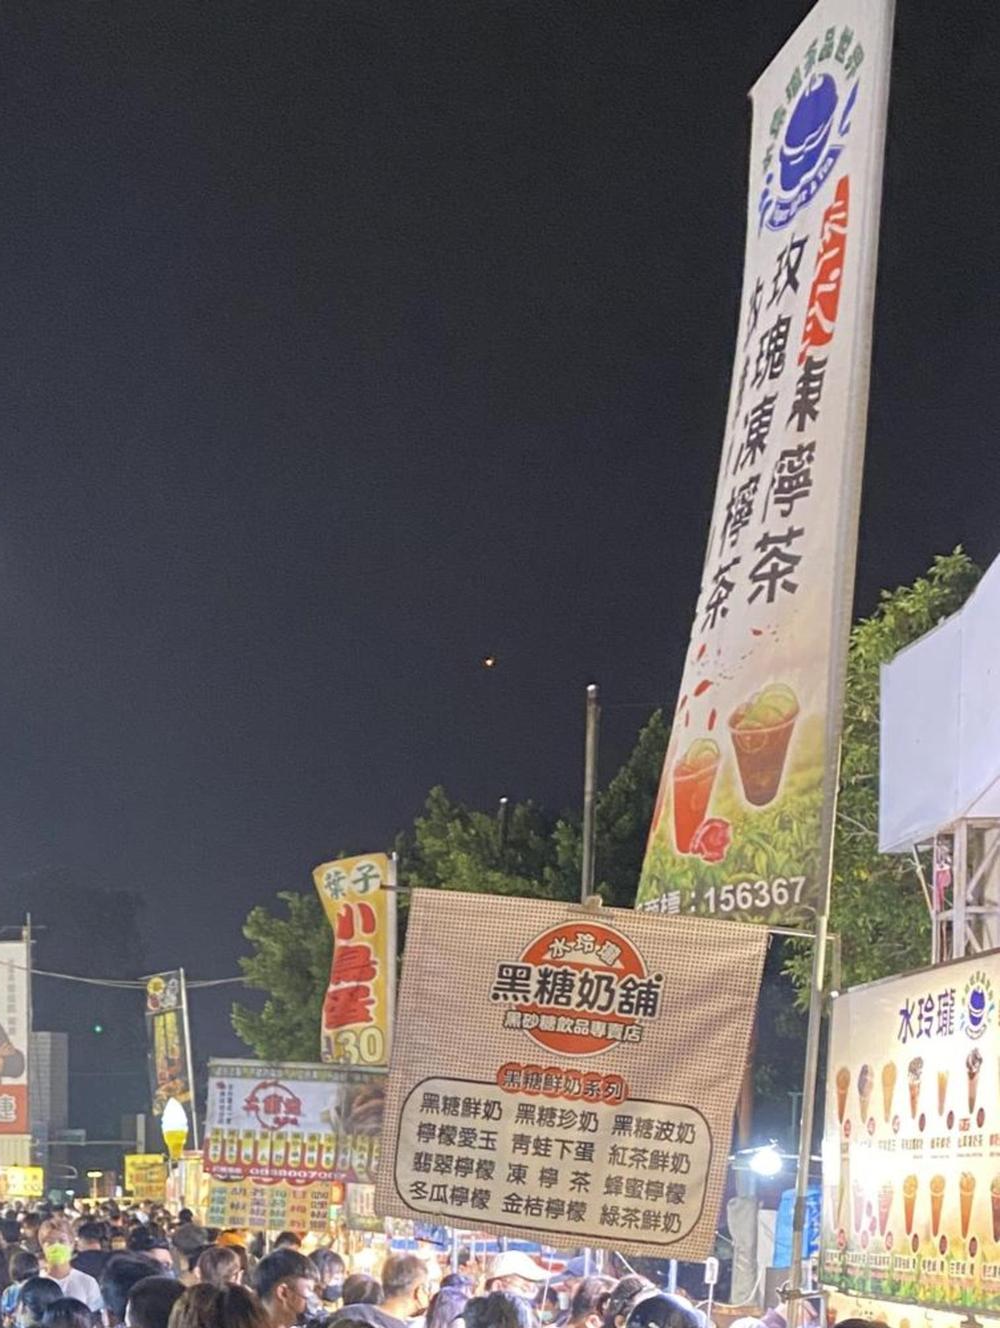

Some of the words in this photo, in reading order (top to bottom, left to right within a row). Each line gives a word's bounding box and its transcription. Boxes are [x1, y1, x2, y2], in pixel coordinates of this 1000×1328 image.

[503, 1010, 644, 1042] 黑砂糖飲品專賣店
[898, 988, 956, 1043] 水玲瓏
[503, 1070, 625, 1100] 黑糖鮮奶系列
[419, 1091, 503, 1122] 黑糖鮮奶
[514, 1102, 599, 1134] 黑糖珍奶
[611, 1113, 697, 1145] 黑糖波奶
[417, 1120, 498, 1151] 檸檬愛玉
[511, 1133, 595, 1164] 青蛙下蛋
[608, 1143, 692, 1175] 紅茶鮮奶
[412, 1150, 497, 1181] 翡翠檸檬
[507, 1162, 592, 1194] 凍檸茶
[603, 1173, 688, 1206] 蜂蜜檸檬
[409, 1180, 492, 1211] 冬瓜檸檬
[501, 1191, 588, 1223] 金桔檸檬
[600, 1203, 683, 1234] 綠茶鮮奶
